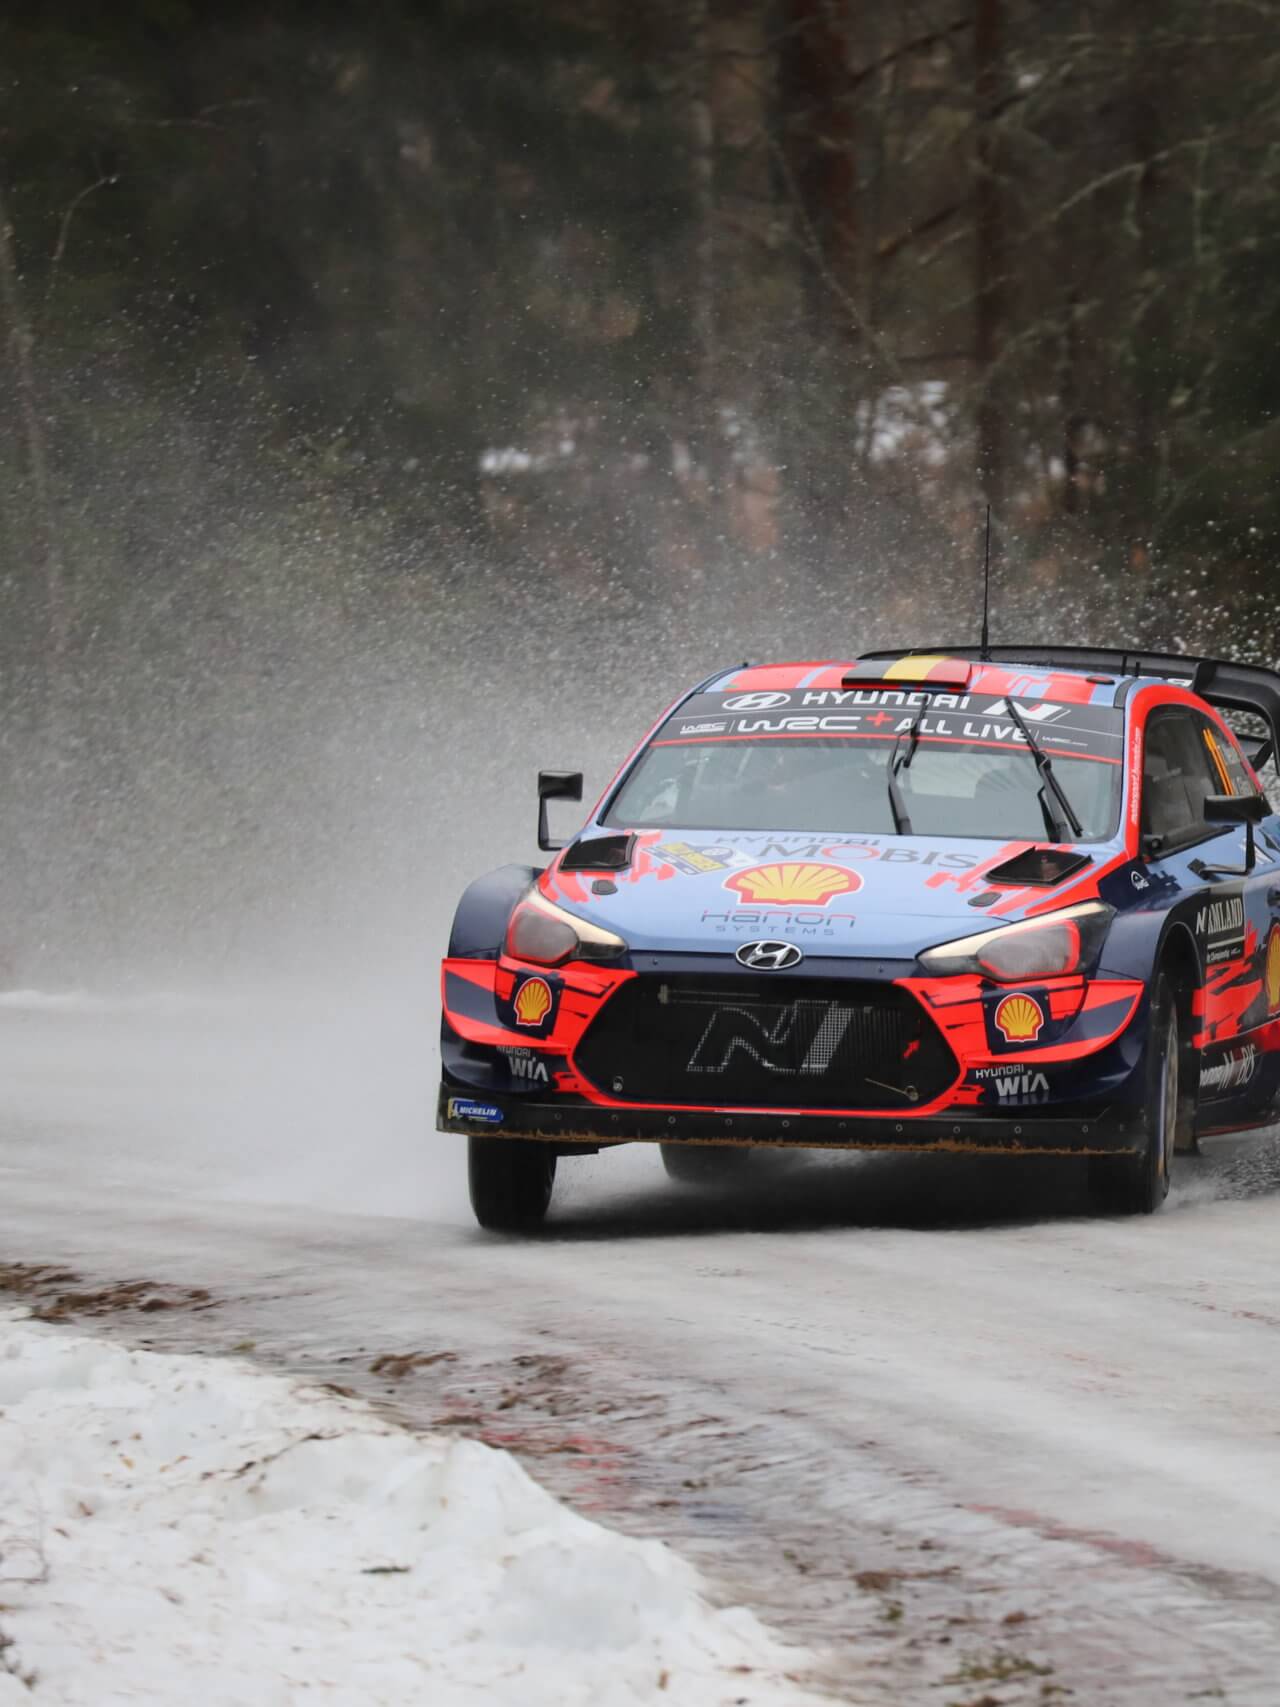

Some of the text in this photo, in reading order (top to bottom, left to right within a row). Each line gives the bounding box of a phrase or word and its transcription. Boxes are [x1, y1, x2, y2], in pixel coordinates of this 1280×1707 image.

[802, 690, 970, 709] HYUNDAI
[737, 716, 862, 732] WRC
[894, 717, 952, 734] ALL
[963, 721, 1029, 742] LIVE
[715, 836, 881, 846] HYUNDAI
[759, 844, 980, 868] MOBIS
[715, 925, 835, 936] SYSTEMS
[976, 1064, 1025, 1079] HYUNDAI
[459, 1106, 498, 1117] MICHELIN
